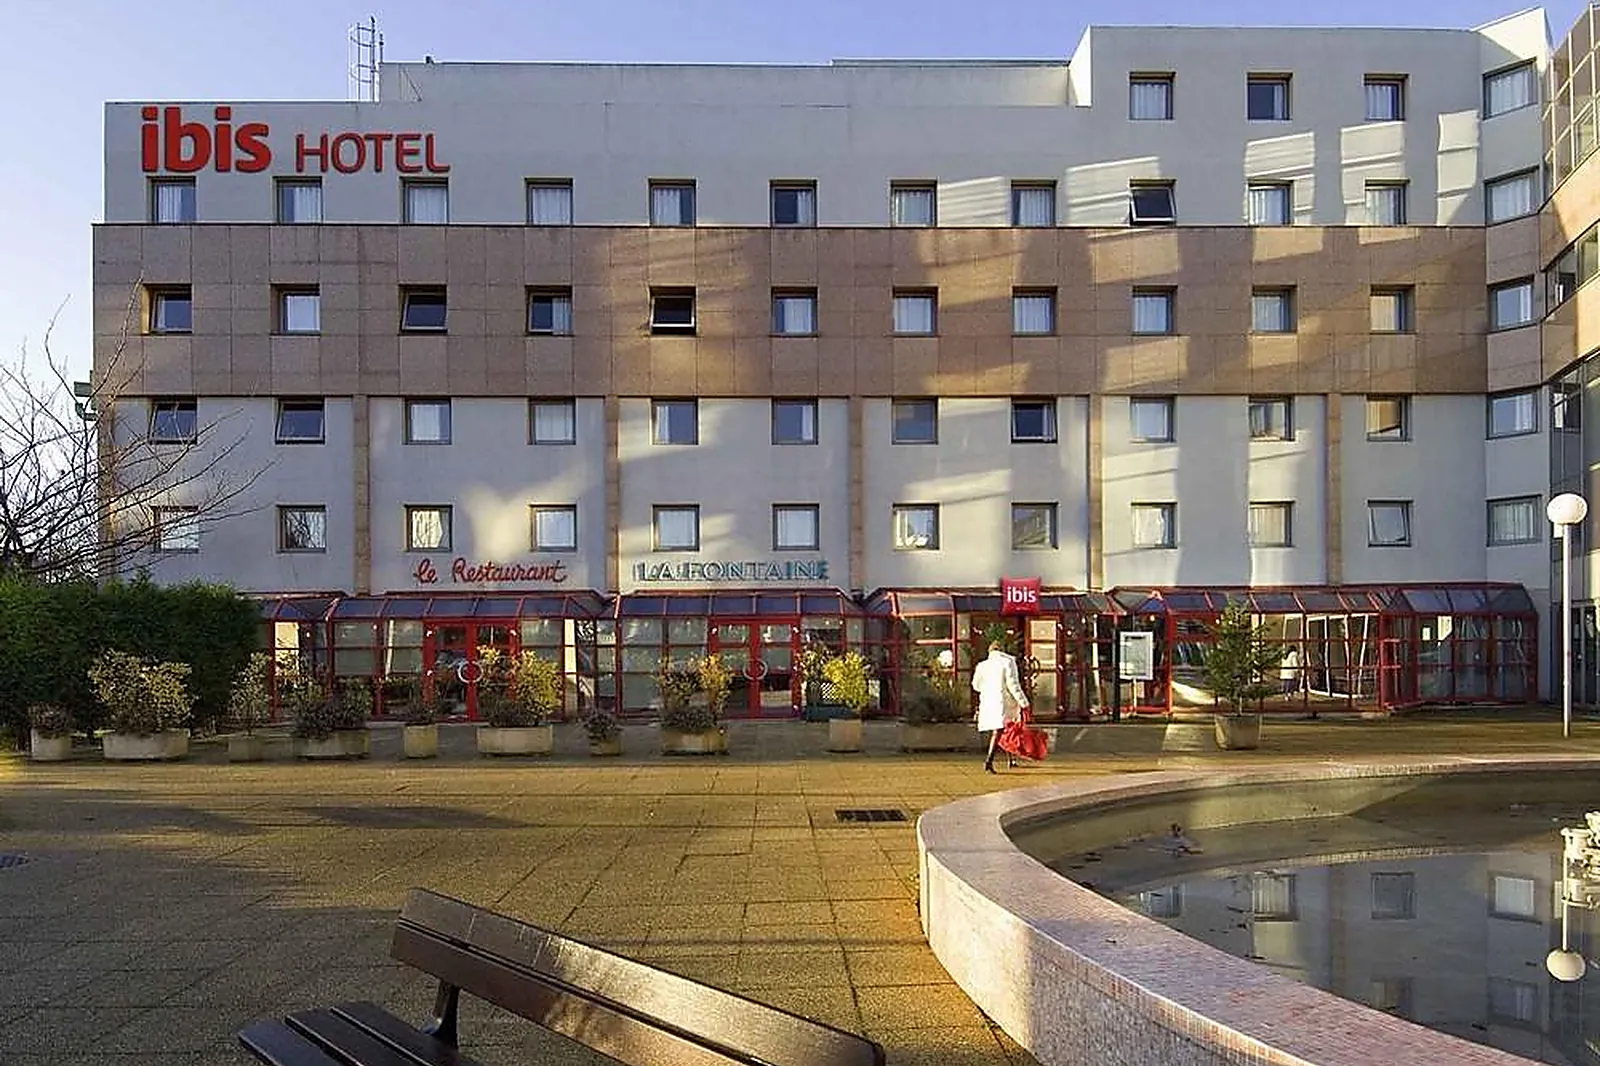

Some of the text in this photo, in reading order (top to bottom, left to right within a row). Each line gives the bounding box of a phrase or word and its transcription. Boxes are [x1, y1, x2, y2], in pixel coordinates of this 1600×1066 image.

[141, 106, 451, 174] ibis HOTEL
[413, 557, 567, 583] le Restaurant
[685, 560, 829, 580] FONTAINE
[1007, 586, 1037, 603] ibis
